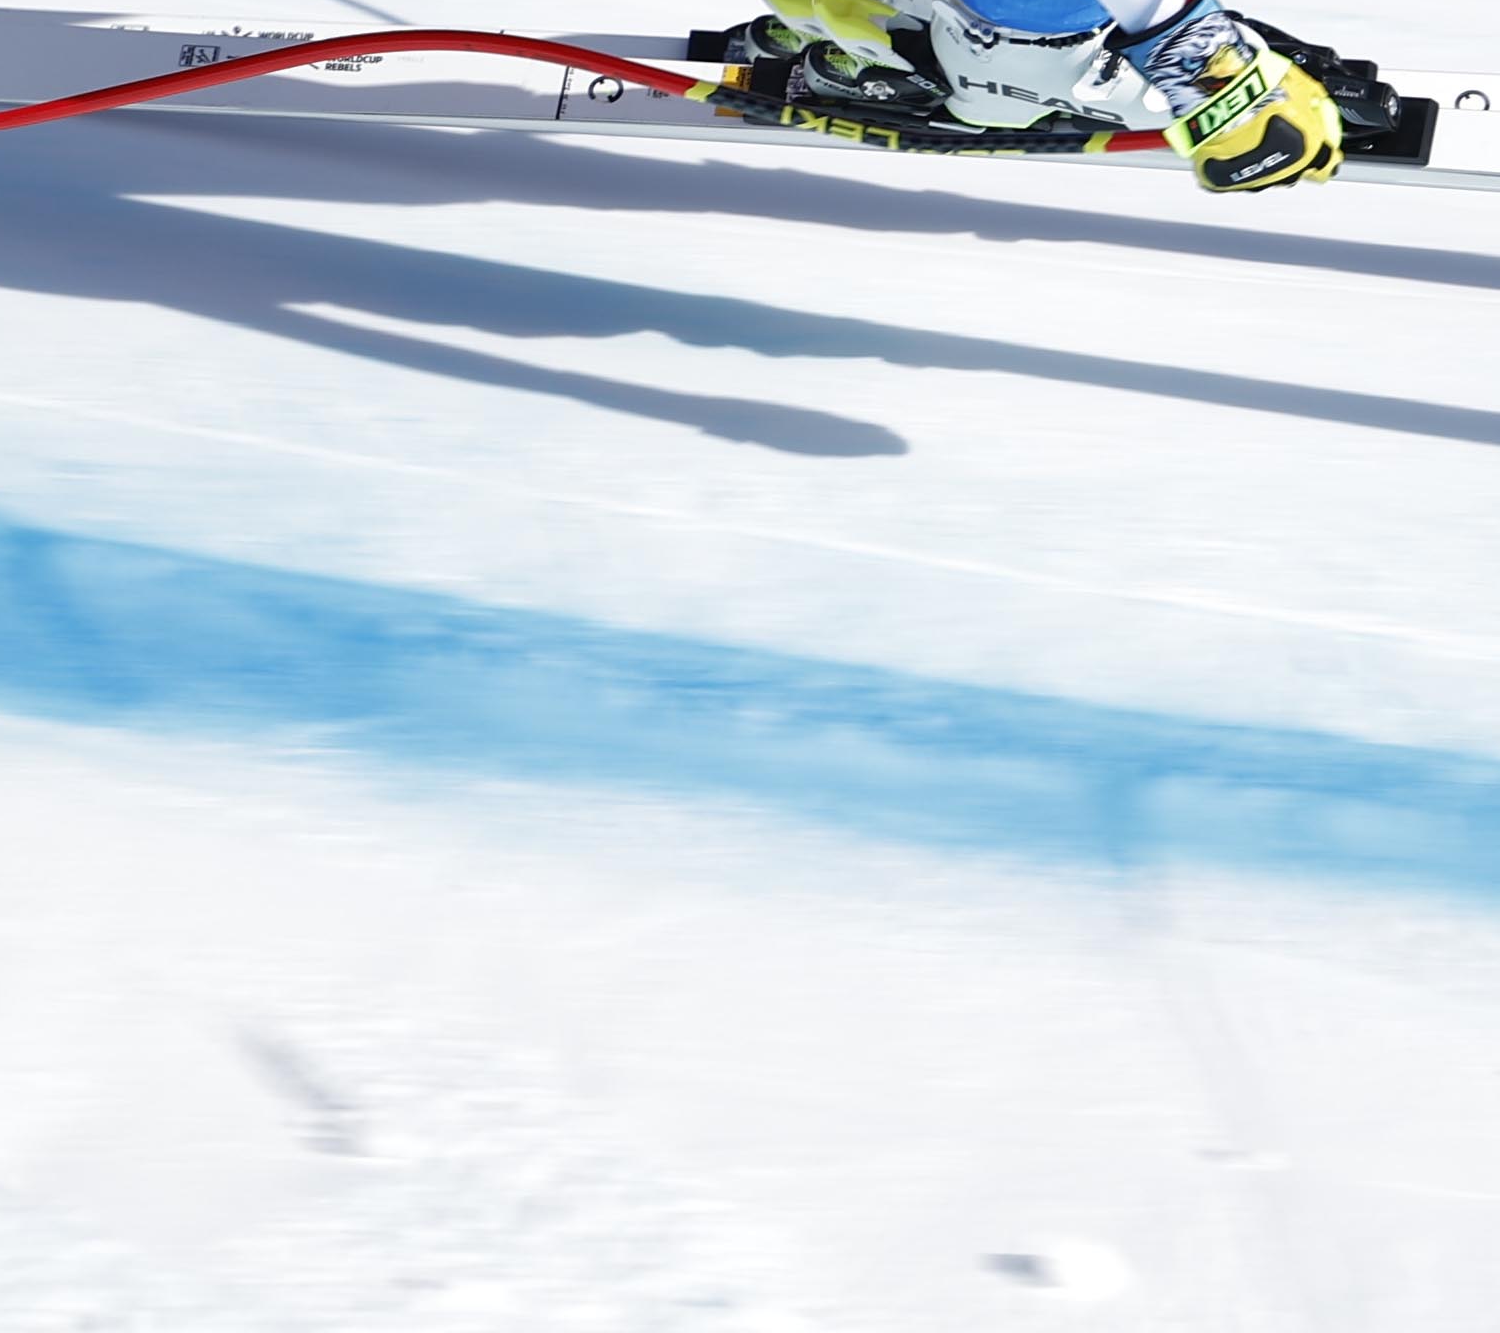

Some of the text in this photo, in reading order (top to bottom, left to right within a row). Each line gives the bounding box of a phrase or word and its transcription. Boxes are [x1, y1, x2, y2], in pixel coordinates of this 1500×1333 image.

[325, 63, 361, 73] REBELS
[958, 75, 1124, 122] HEAD
[1197, 70, 1266, 136] LEKI
[779, 105, 899, 150] LEKI
[1230, 151, 1291, 182] LEVEL
